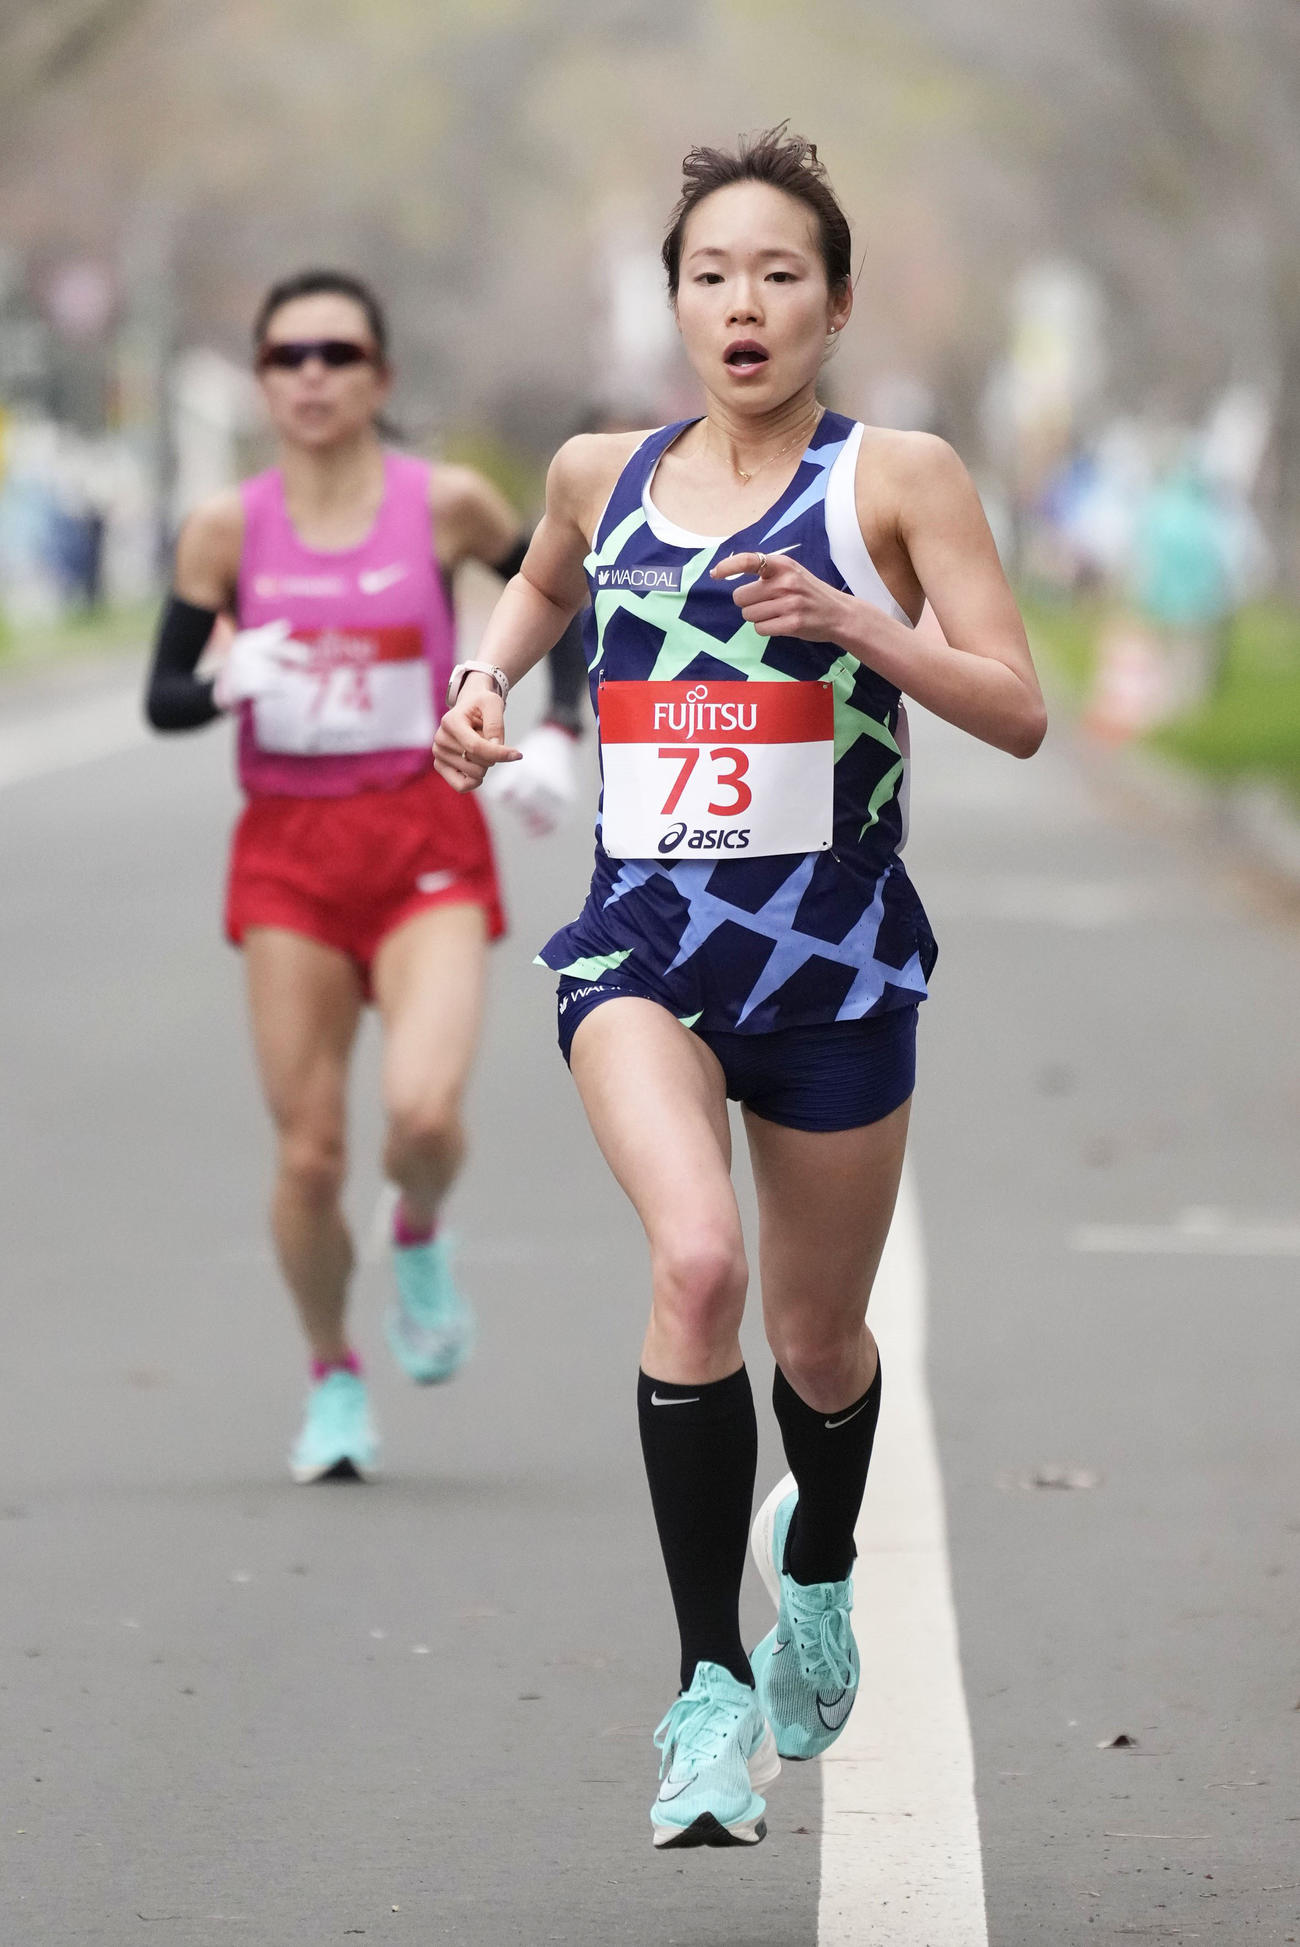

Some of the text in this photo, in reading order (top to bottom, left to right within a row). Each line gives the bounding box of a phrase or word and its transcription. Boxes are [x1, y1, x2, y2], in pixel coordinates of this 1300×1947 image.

[611, 569, 678, 588] WACOAL
[653, 685, 758, 740] FUJITSU
[657, 747, 752, 817] 73
[687, 829, 751, 849] asics
